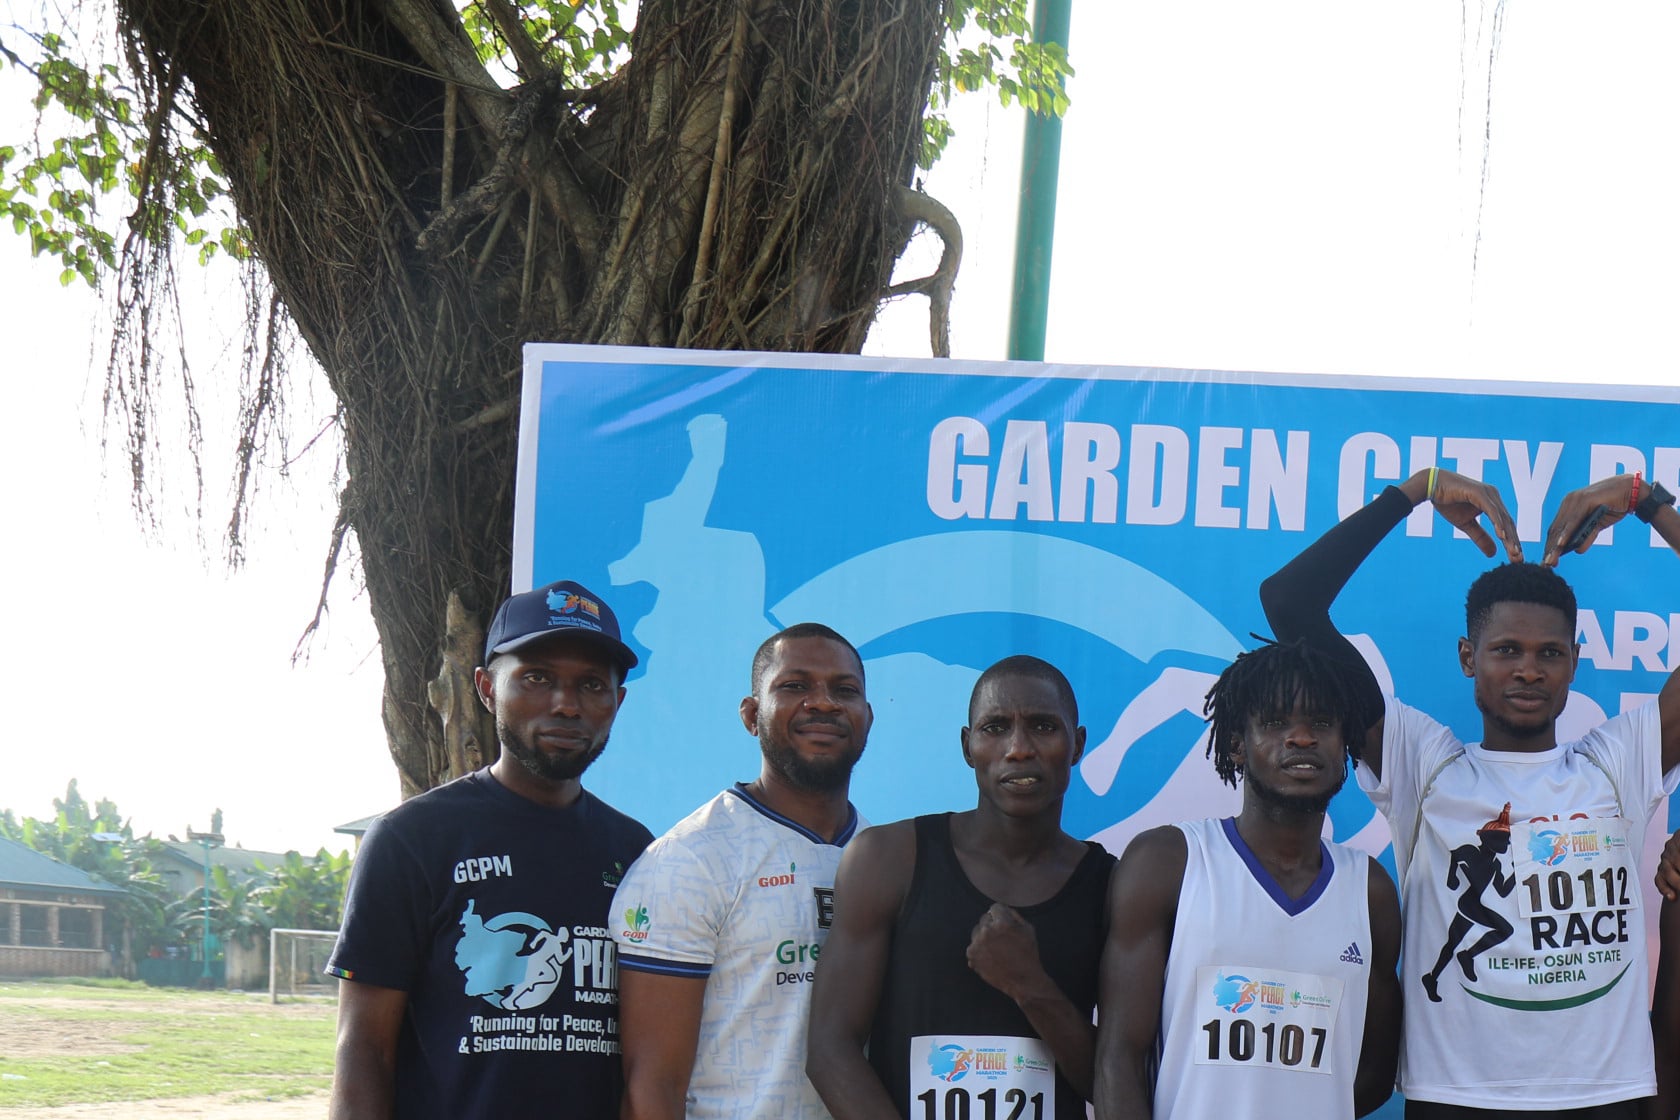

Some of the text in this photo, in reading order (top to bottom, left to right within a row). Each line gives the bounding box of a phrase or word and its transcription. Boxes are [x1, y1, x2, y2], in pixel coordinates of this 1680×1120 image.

[927, 416, 1309, 531] GARDEN
[1338, 432, 1564, 543] CITY
[454, 854, 513, 883] GCPM
[1522, 866, 1630, 913] 10112
[573, 925, 611, 937] GARD
[622, 930, 649, 941] GODI
[1530, 910, 1629, 950] RACE
[573, 938, 618, 989] PEA
[776, 940, 822, 965] Gre
[1339, 954, 1363, 966] adidas
[1488, 949, 1621, 971] ILE-IFE, OSUN STATE
[1528, 969, 1587, 985] NIGERIA
[538, 1014, 559, 1031] for
[563, 1014, 605, 1035] Peace,
[458, 1036, 470, 1054] &
[473, 1034, 562, 1052] Sustainable
[1202, 1019, 1327, 1068] 10107
[975, 1053, 1008, 1070] PEACE
